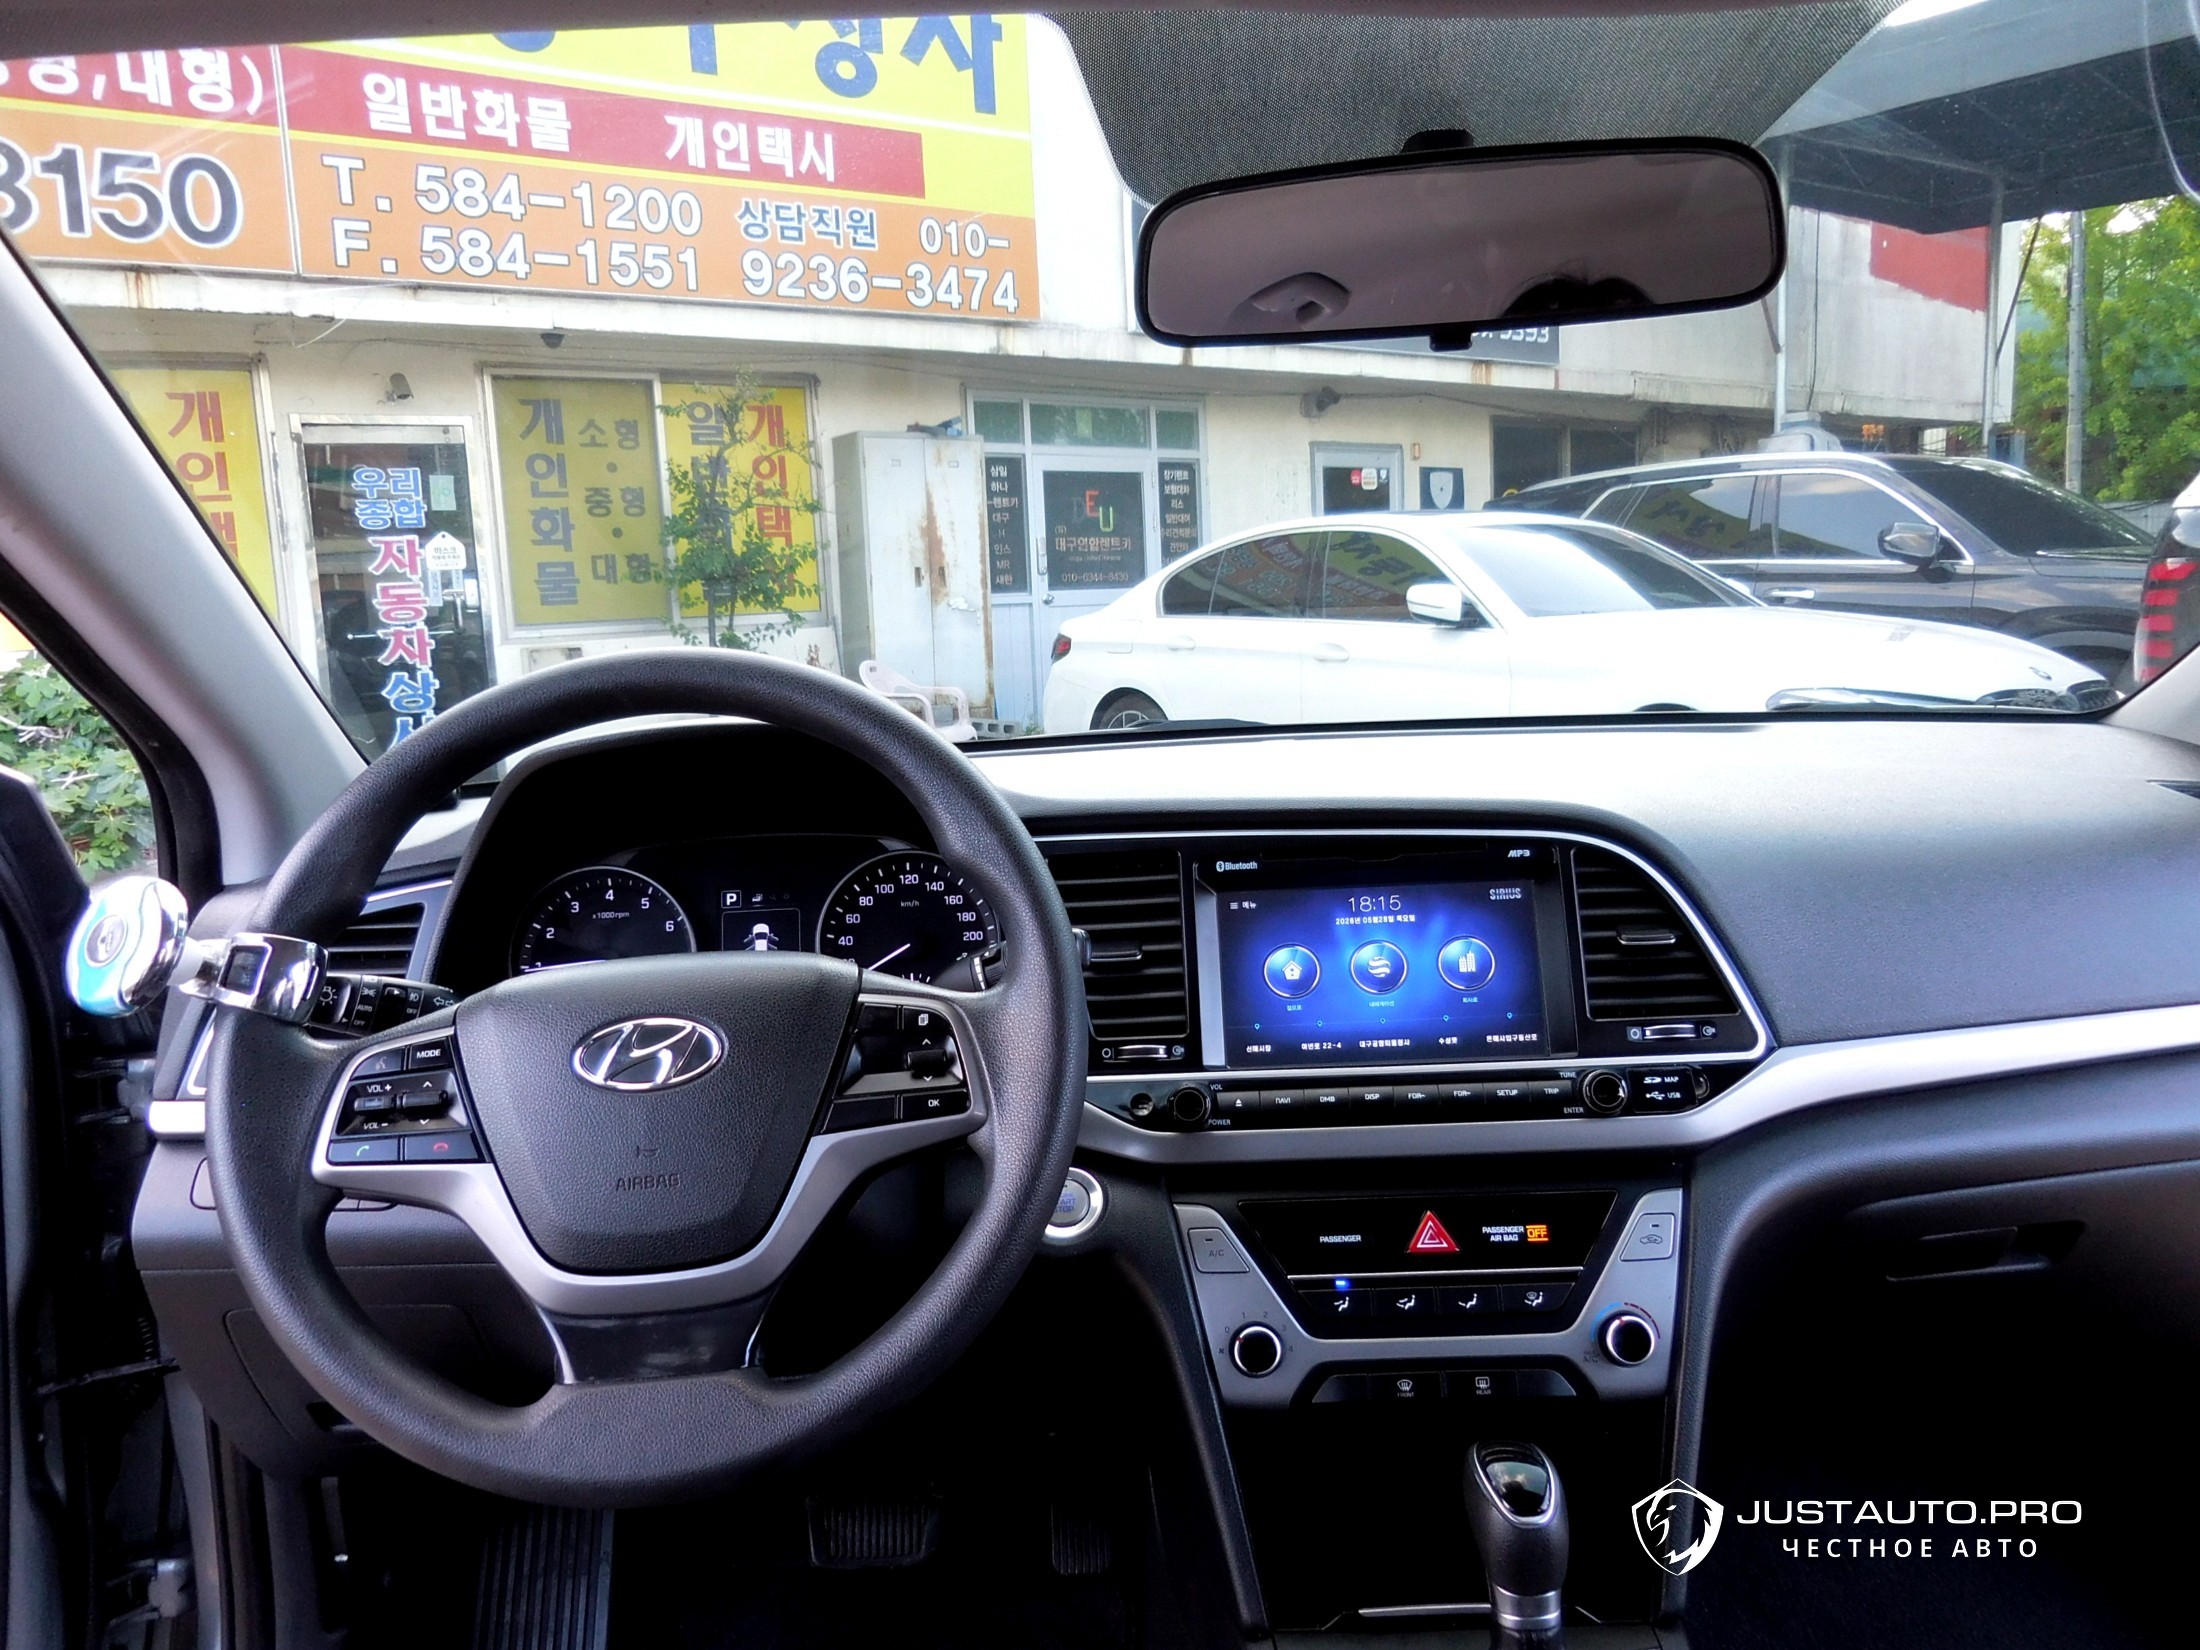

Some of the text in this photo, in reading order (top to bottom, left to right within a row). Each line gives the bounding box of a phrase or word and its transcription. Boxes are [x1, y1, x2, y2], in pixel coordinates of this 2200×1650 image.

[362, 72, 835, 182] 일반화물 개인택시
[414, 163, 703, 236] 584-1200
[737, 198, 878, 251] 상담직원
[919, 217, 1010, 259] 010-
[420, 224, 699, 292] 584-1551
[741, 249, 1019, 314] 9236-3474
[578, 419, 641, 450] 소형
[352, 467, 423, 499] 우리
[517, 398, 581, 606] 개인화물
[584, 486, 646, 518] 중형
[354, 497, 426, 530] 종합
[591, 553, 652, 585] 대형
[1507, 849, 1530, 857] MP3
[1225, 861, 1258, 870] Bluetooth
[900, 874, 919, 884] 120
[875, 884, 895, 894] 100
[925, 881, 945, 892] 140
[605, 889, 614, 901] 4
[726, 893, 738, 906] P
[1489, 887, 1522, 900] SIRIUS
[641, 897, 650, 909] 5
[859, 896, 874, 906] 80
[944, 895, 963, 905] 160
[1348, 895, 1401, 912] 18:15
[570, 901, 579, 913] 3
[845, 913, 861, 923] 60
[956, 911, 976, 922] 180
[665, 920, 674, 932] 6
[546, 927, 555, 939] 2
[963, 931, 984, 941] 200
[838, 935, 853, 946] 40
[357, 1003, 373, 1012] AUTO
[416, 1049, 441, 1059] MODE
[1544, 1087, 1559, 1095] TRIP
[1667, 1091, 1681, 1099] USB
[928, 1099, 940, 1107] OK
[616, 1173, 680, 1191] AIRBAG
[1482, 1226, 1547, 1238] PASSENGER OFF
[1490, 1234, 1501, 1242] AIR
[1319, 1234, 1362, 1243] PASSENGER
[1209, 1249, 1225, 1257] A/C
